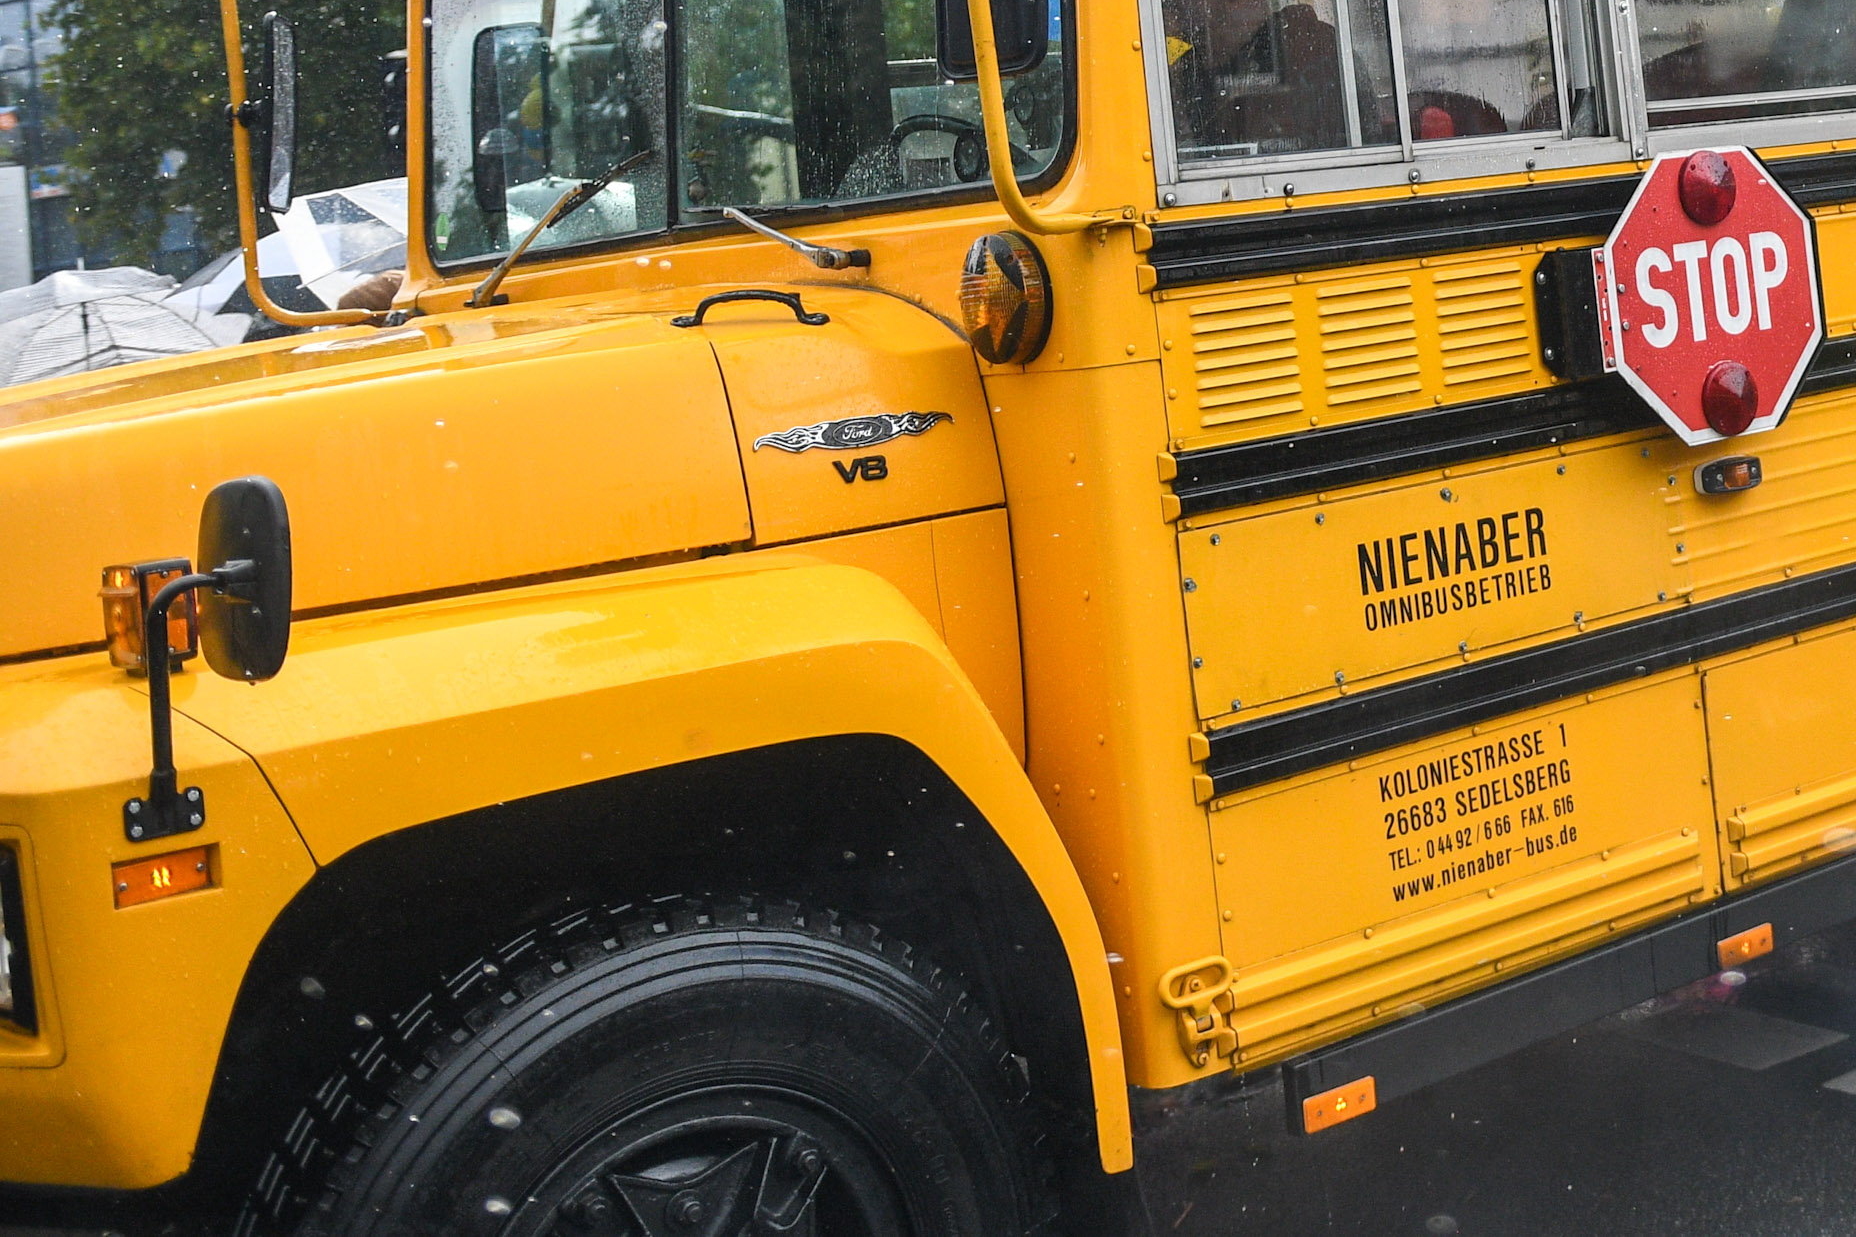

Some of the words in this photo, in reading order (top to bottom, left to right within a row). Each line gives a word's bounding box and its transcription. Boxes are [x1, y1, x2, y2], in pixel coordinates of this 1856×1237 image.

[1635, 231, 1788, 348] STOP
[832, 455, 888, 484] V8
[842, 424, 874, 440] Ford
[1358, 507, 1548, 596] NIENABER
[1365, 564, 1551, 631] OMNIBUSBETRIEB
[1379, 730, 1545, 803] KOLONIESTRASSE
[1558, 723, 1568, 748] 1
[1384, 797, 1447, 840] 26683
[1455, 759, 1571, 816] SEDELSBERG
[1389, 847, 1422, 871] TEL.:
[1521, 804, 1549, 828] FAX.
[1554, 795, 1575, 817] 616
[1393, 824, 1578, 901] www.nienaber-bus.de
